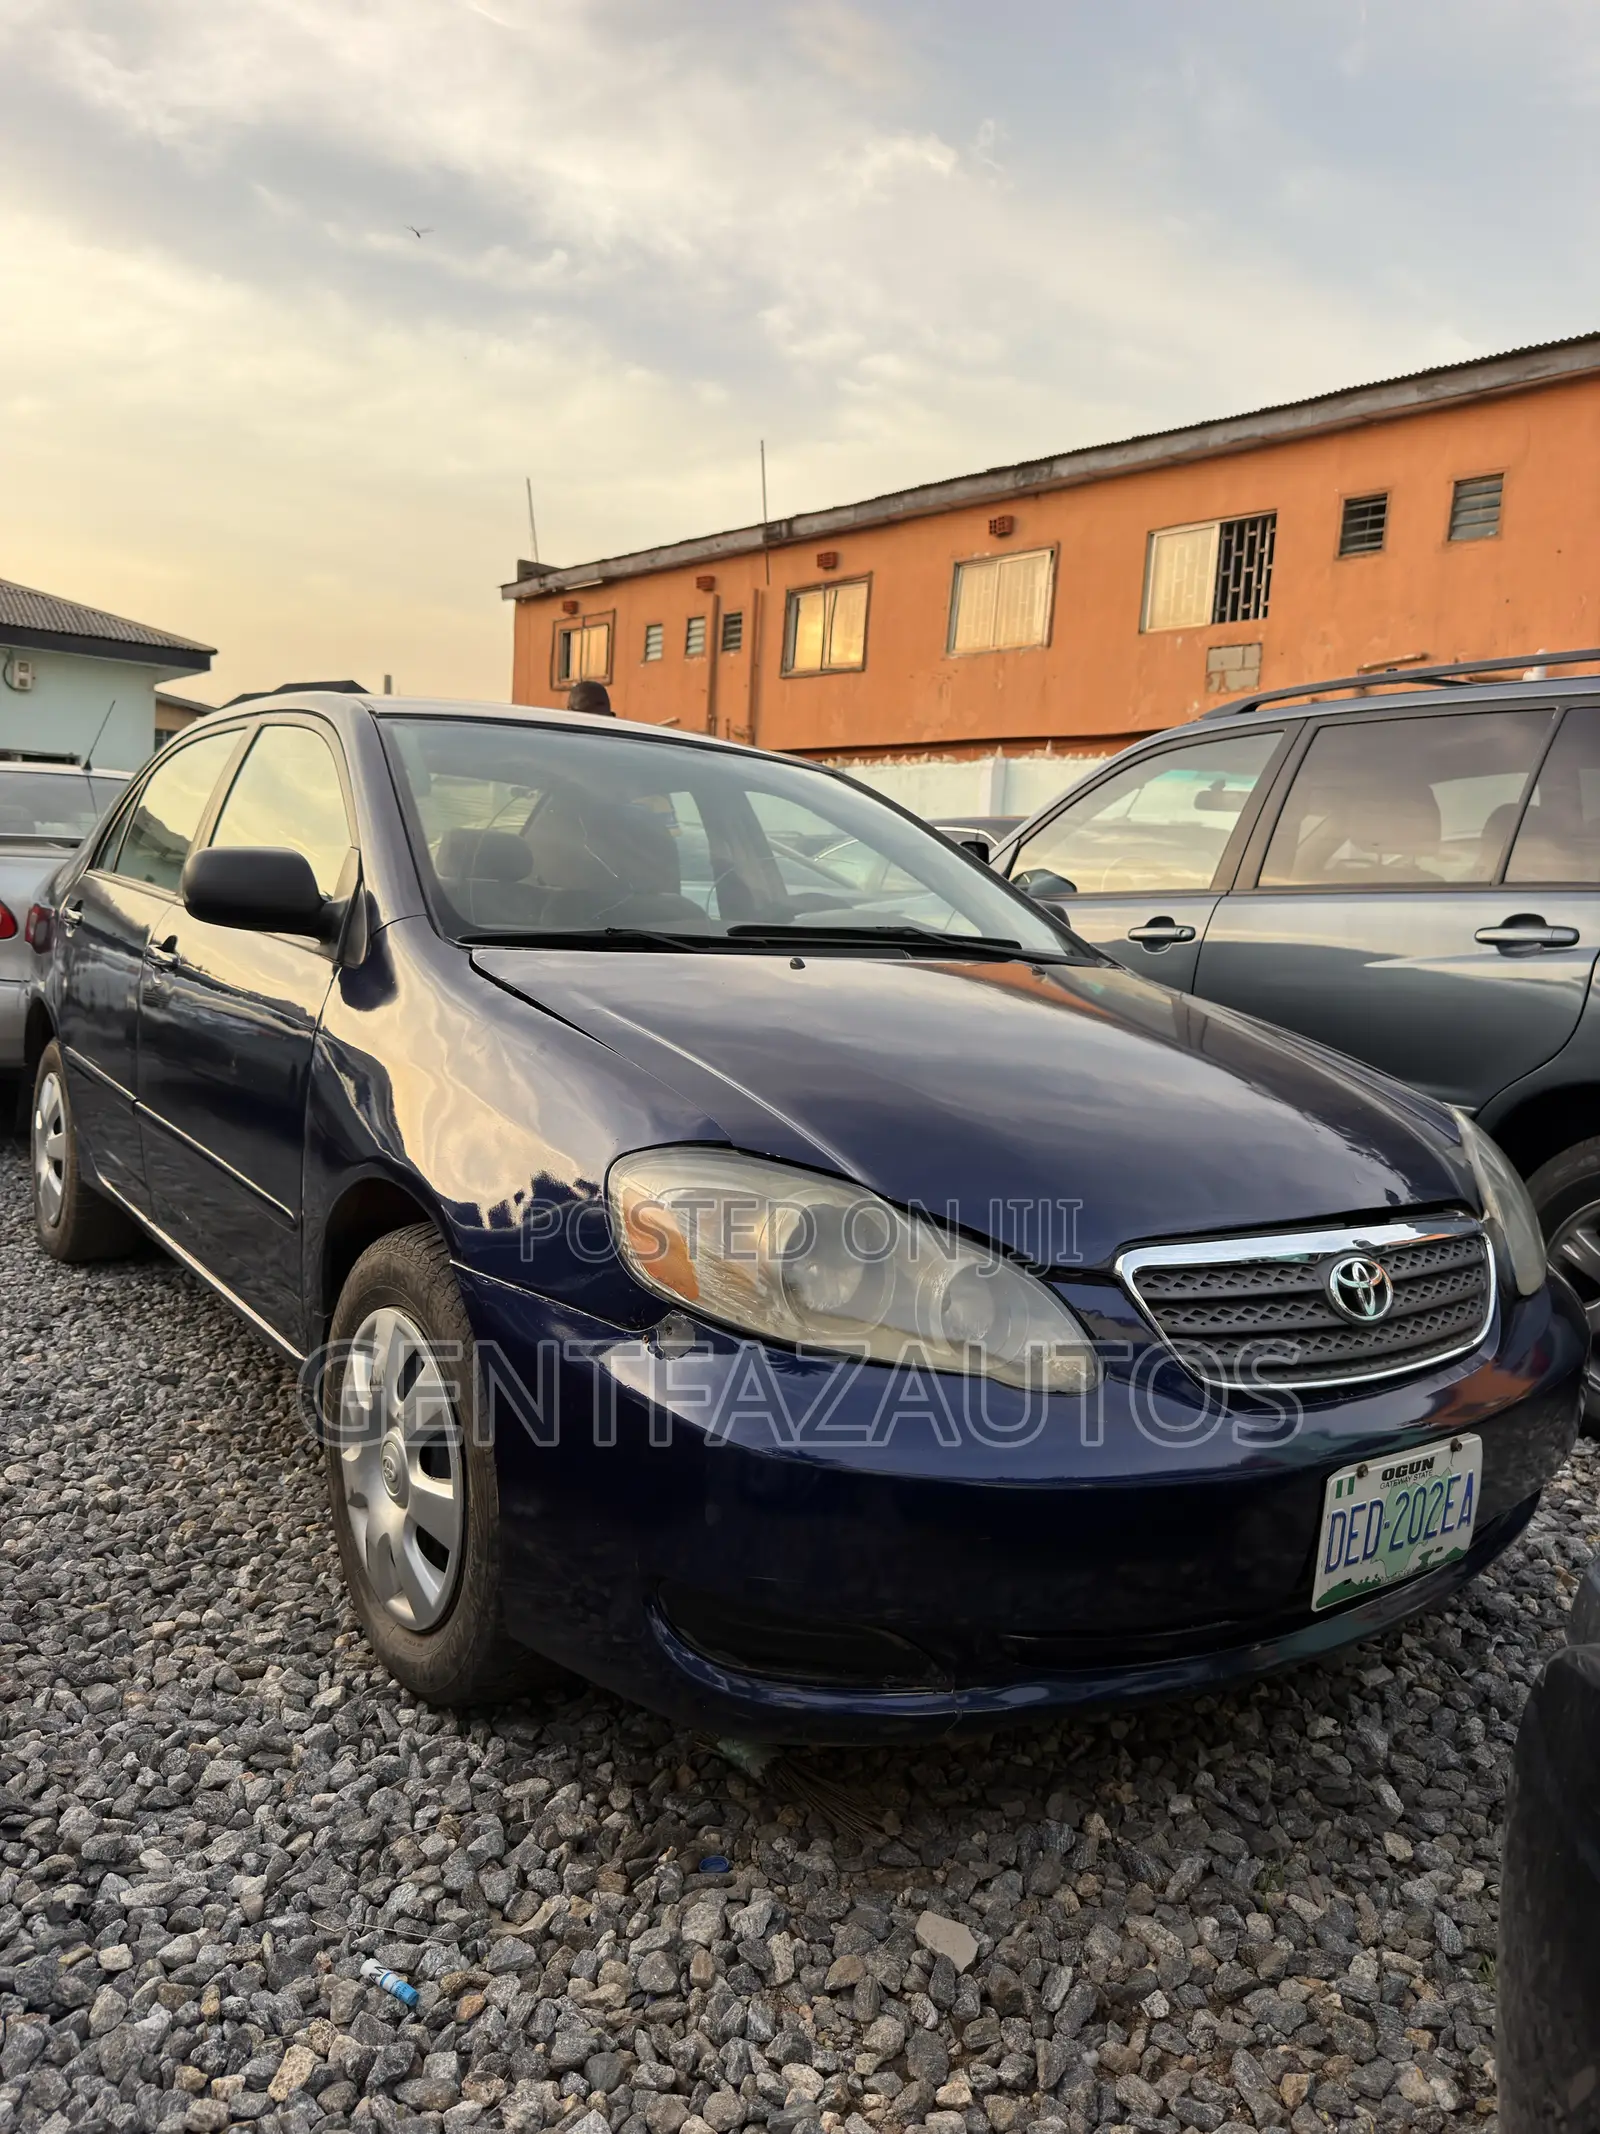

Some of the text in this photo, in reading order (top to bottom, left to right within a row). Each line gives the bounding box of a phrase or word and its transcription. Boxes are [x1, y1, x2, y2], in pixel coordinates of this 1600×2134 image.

[1380, 1469, 1433, 1490] GATEWAY STATE
[1381, 1456, 1435, 1481] OGUN
[1325, 1469, 1474, 1574] DED-202EA
